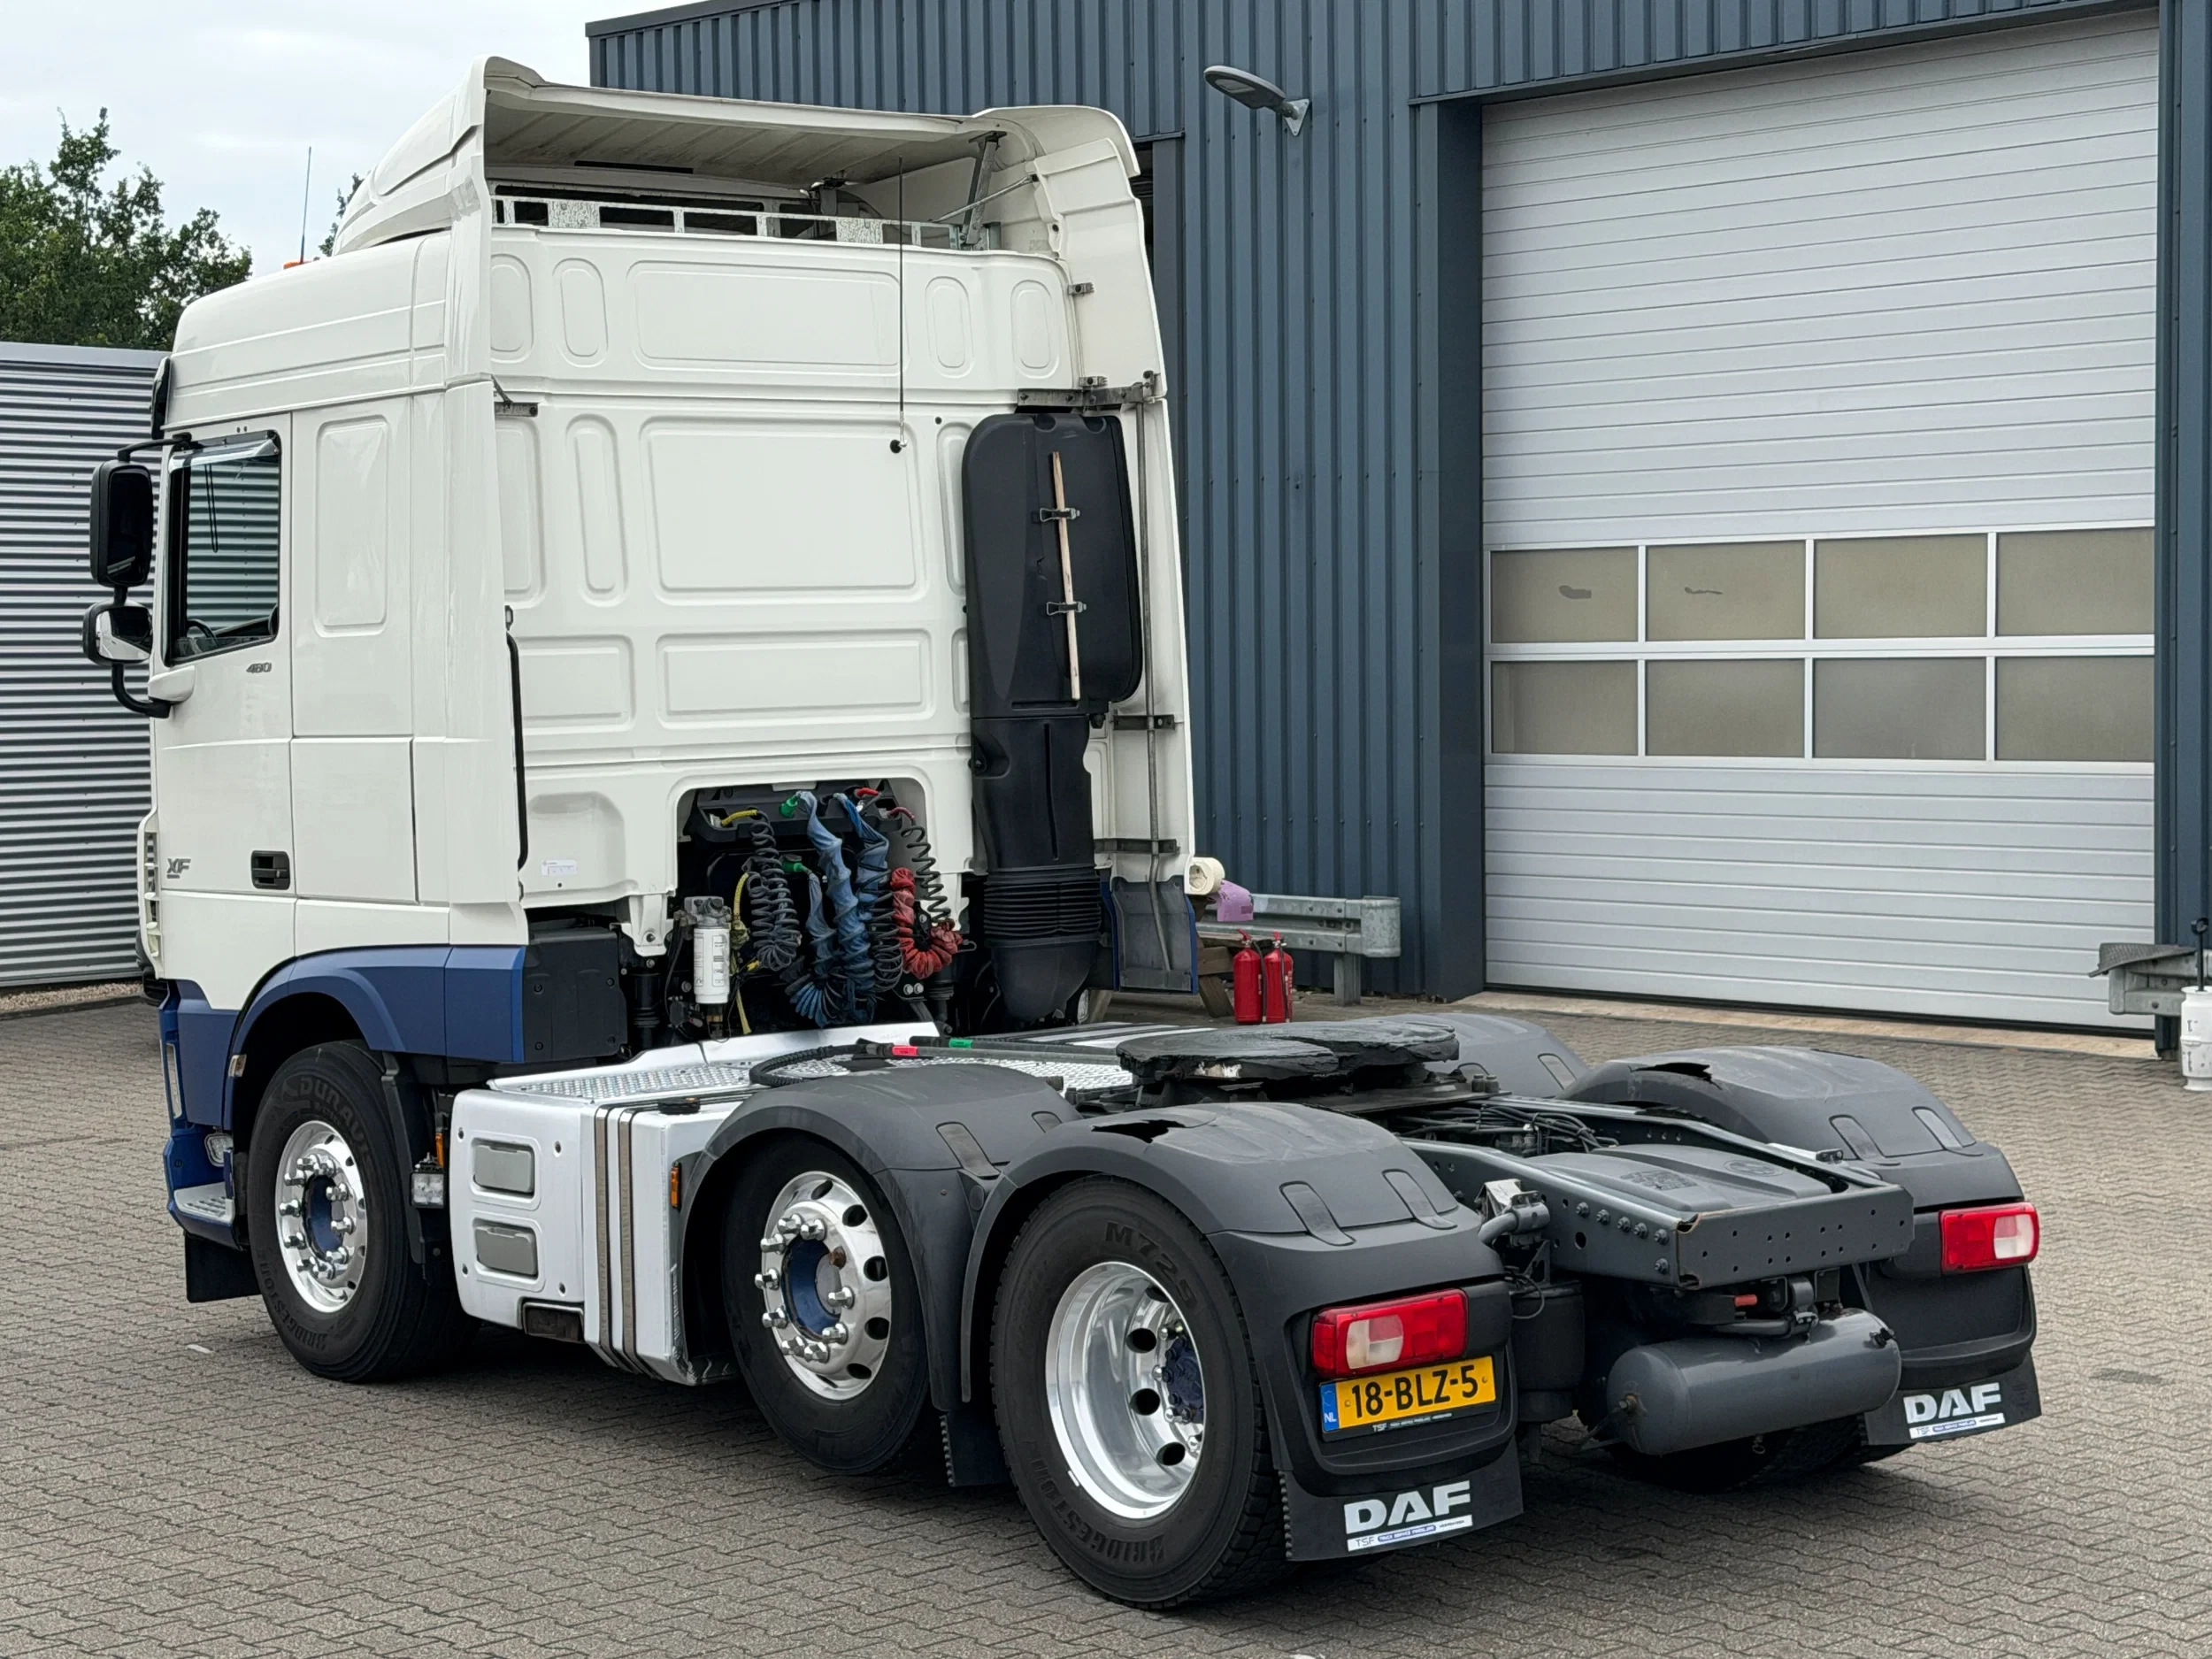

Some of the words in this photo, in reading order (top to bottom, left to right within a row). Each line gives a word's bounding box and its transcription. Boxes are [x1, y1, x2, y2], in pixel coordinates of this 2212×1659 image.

[166, 858, 192, 874] XF
[1351, 1364, 1479, 1418] 18-BLZ-5
[1902, 1381, 2002, 1424] DAF
[1323, 1412, 1337, 1424] NL
[1372, 1423, 1387, 1432] TSF
[1343, 1479, 1471, 1534] DAF
[1355, 1536, 1376, 1548] TSF
